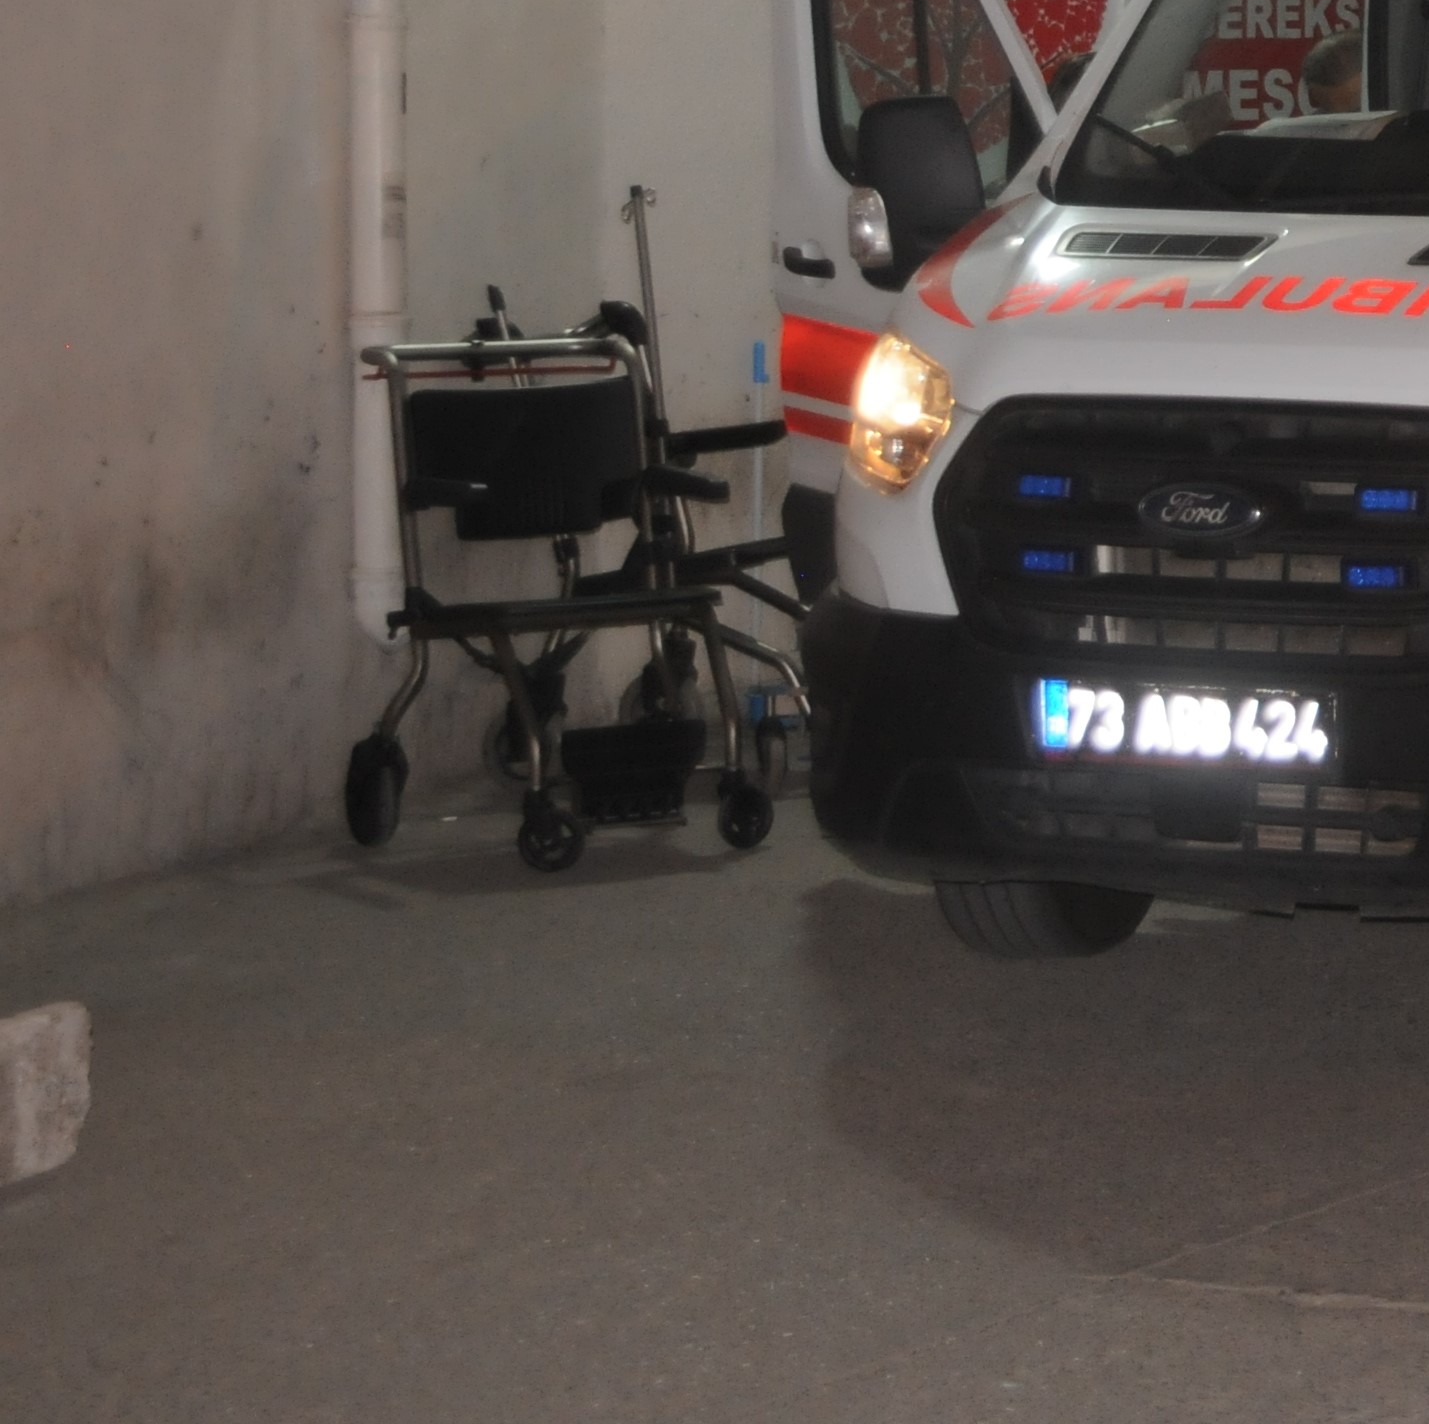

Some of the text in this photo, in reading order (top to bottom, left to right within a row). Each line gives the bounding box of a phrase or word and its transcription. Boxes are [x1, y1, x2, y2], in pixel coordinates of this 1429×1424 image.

[1161, 491, 1231, 524] Ford
[1069, 688, 1125, 753] 73
[1236, 697, 1328, 763] 424
